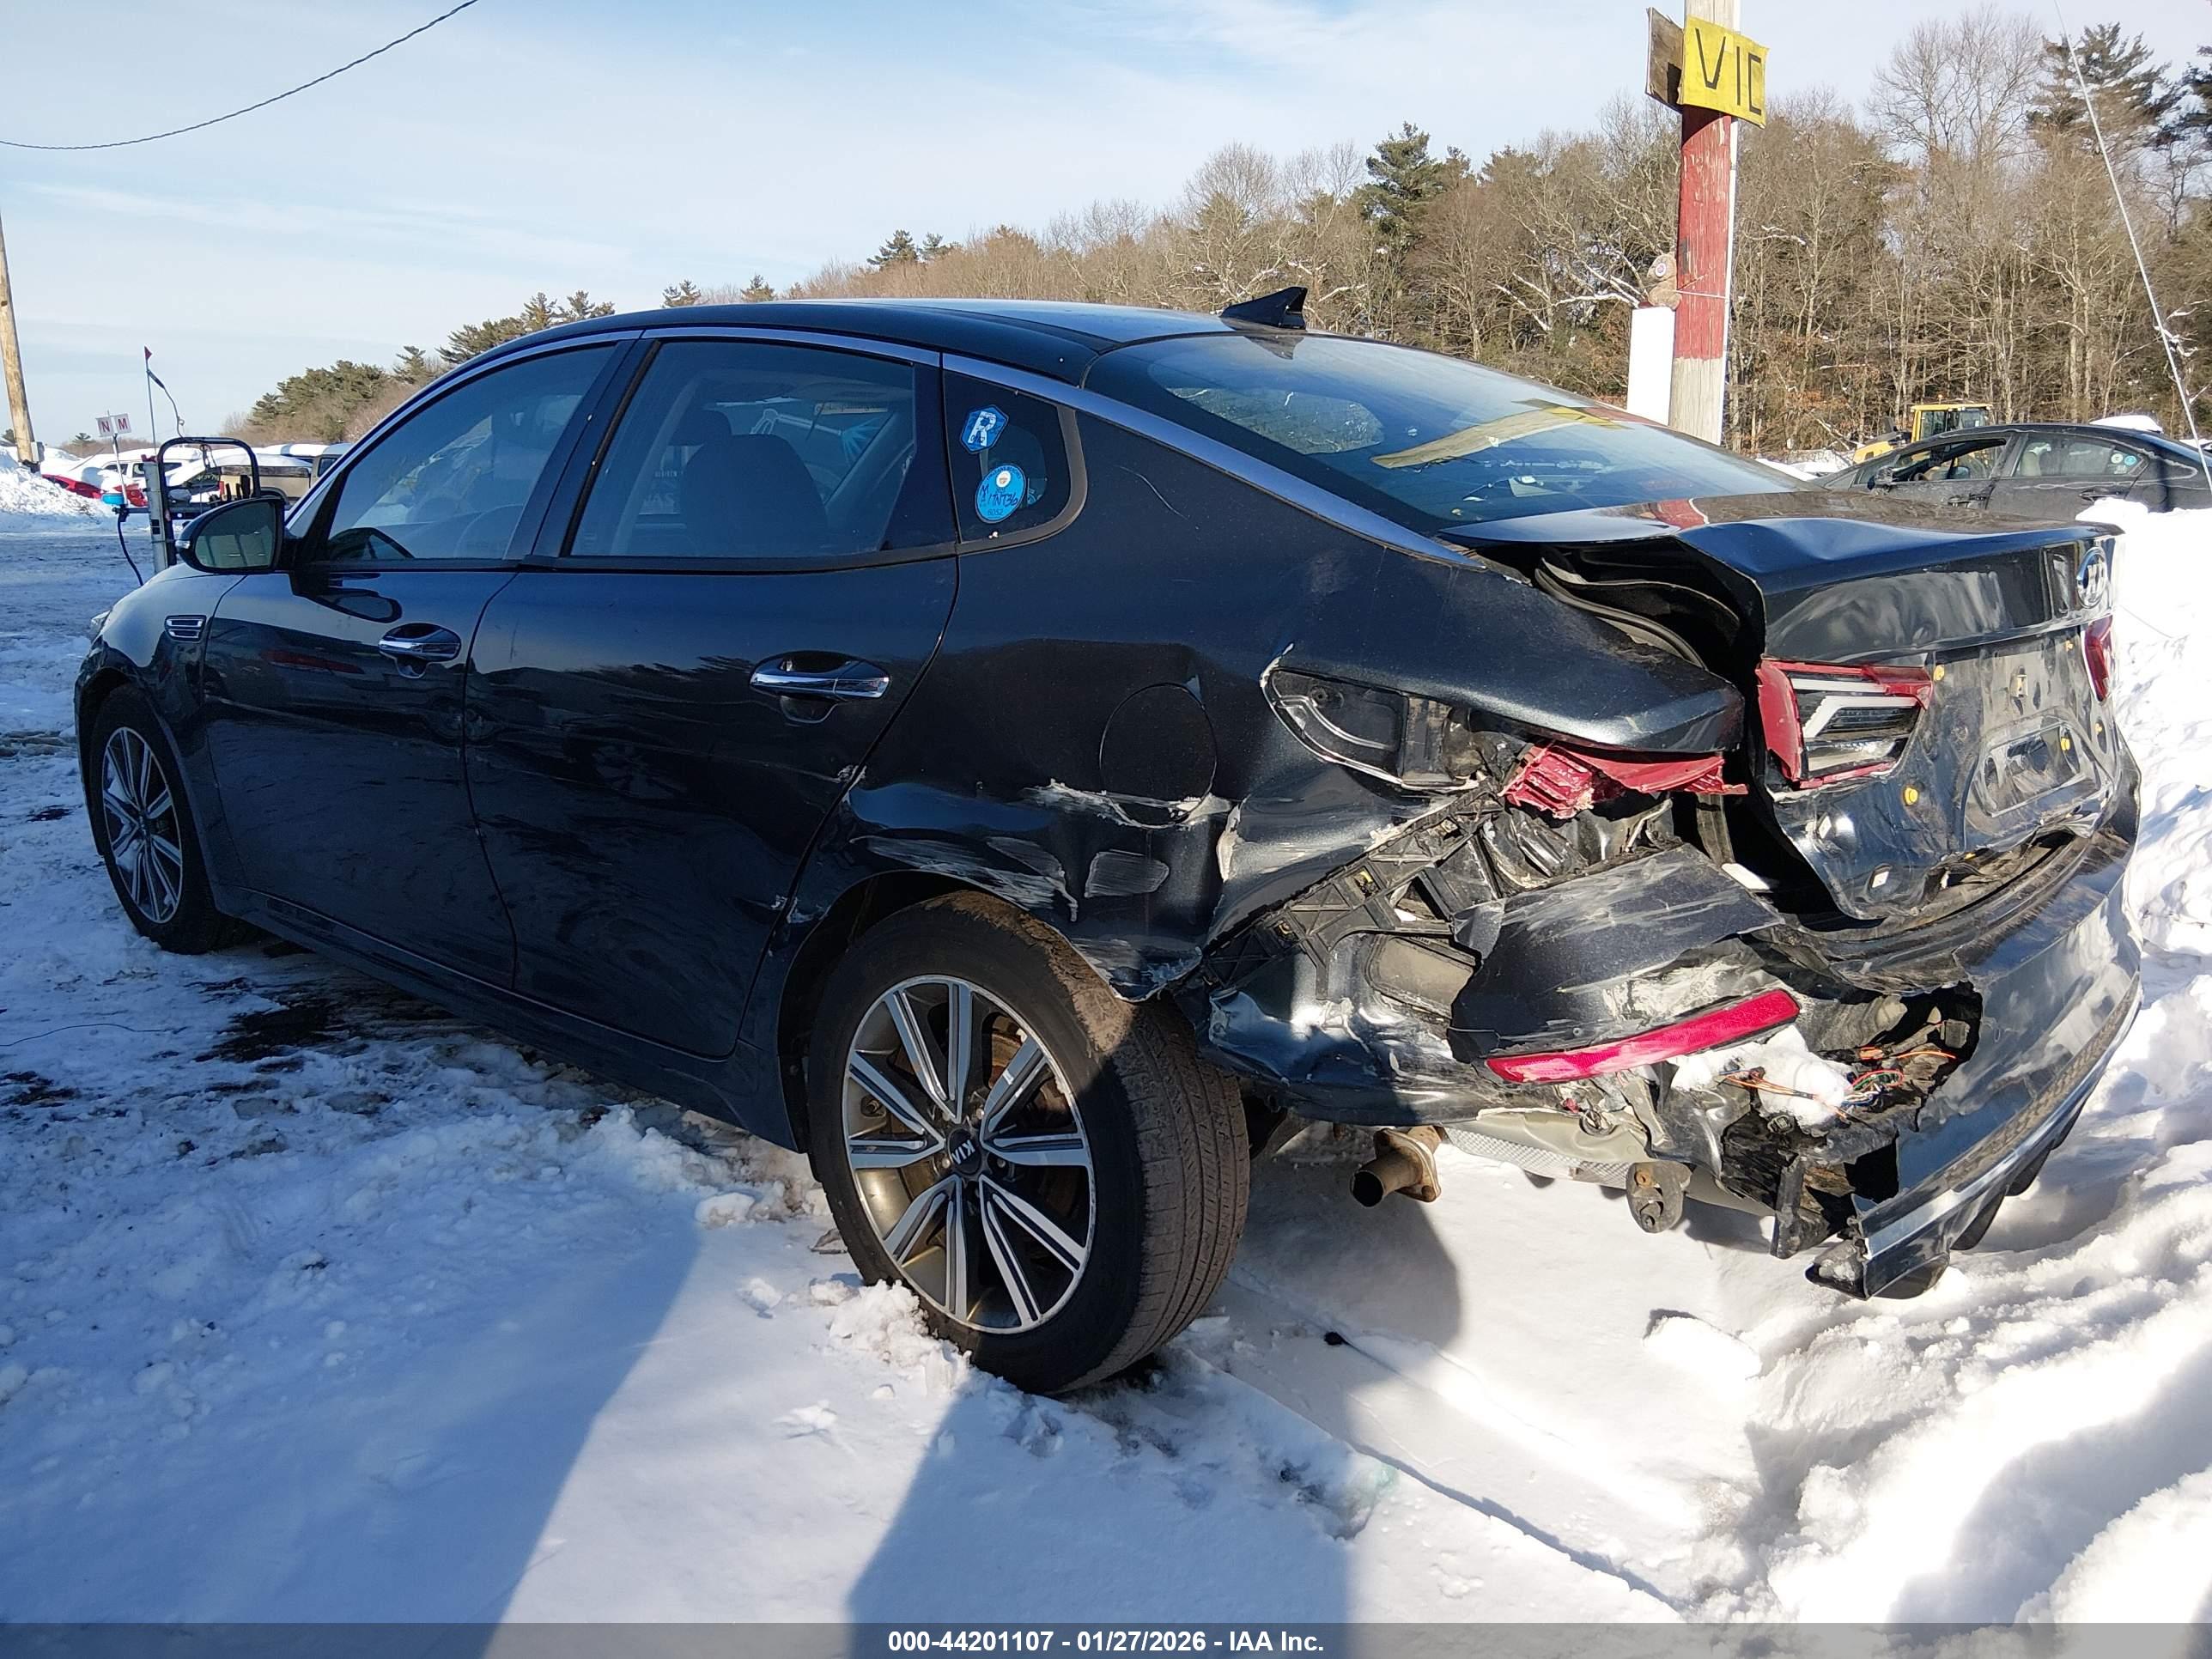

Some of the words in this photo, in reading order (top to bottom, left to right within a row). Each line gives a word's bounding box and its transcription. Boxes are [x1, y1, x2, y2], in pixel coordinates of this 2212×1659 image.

[1694, 27, 1762, 117] VIC
[101, 420, 111, 433] N
[118, 417, 128, 430] M
[967, 410, 997, 447] R
[951, 1139, 976, 1165] KIA
